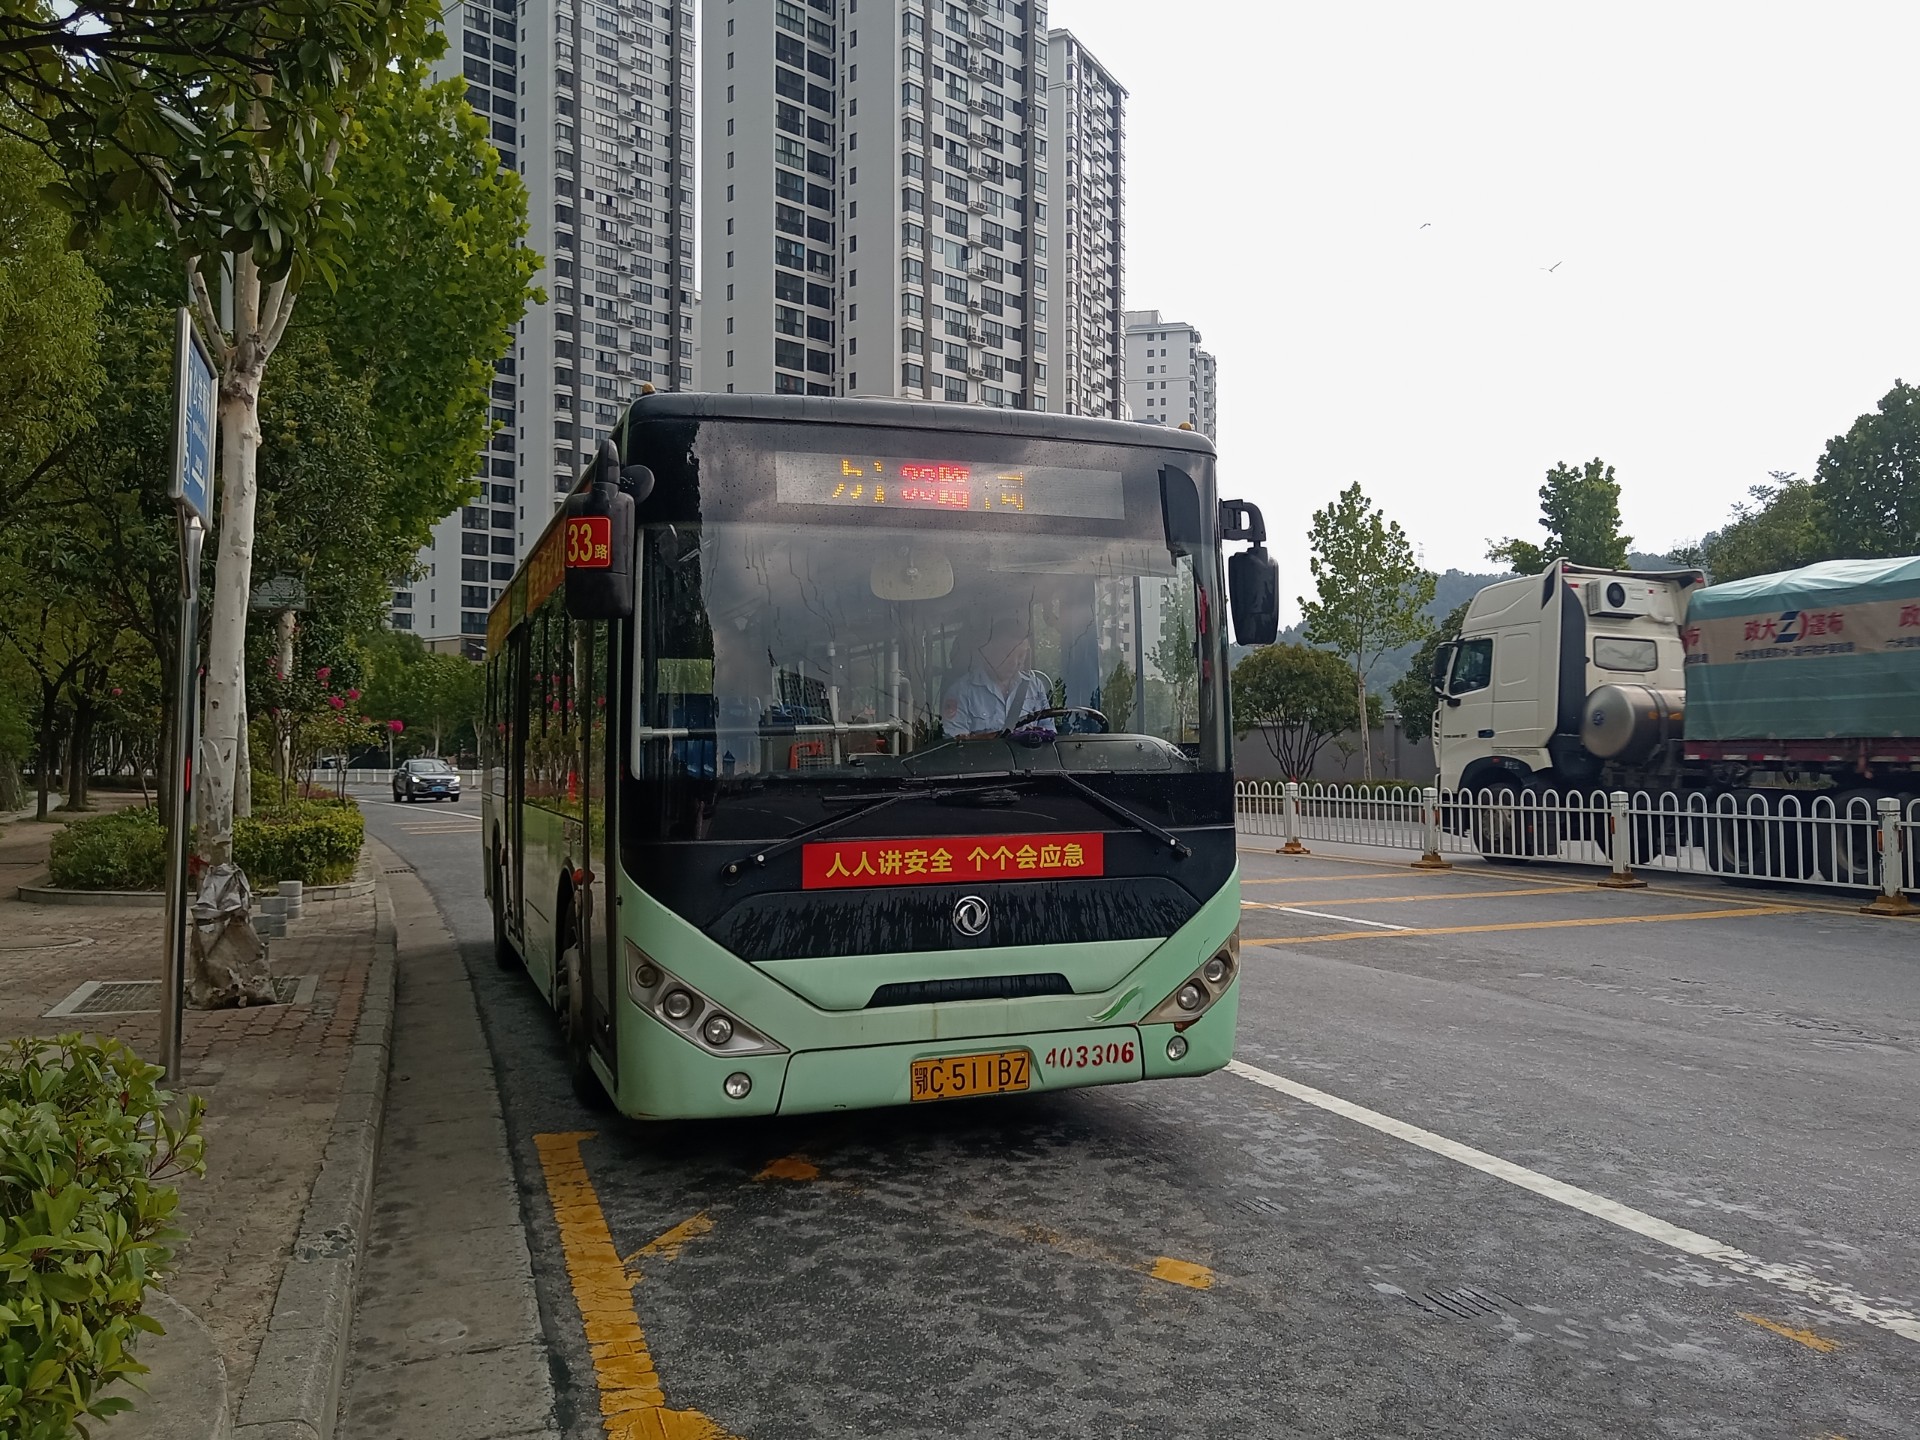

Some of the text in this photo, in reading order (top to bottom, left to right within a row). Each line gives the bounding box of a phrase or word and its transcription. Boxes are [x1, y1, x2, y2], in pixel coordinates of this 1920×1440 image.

[567, 523, 608, 562] 33路
[825, 843, 1085, 879] 人人讲安全 个个会应急
[1045, 1041, 1135, 1069] 403306
